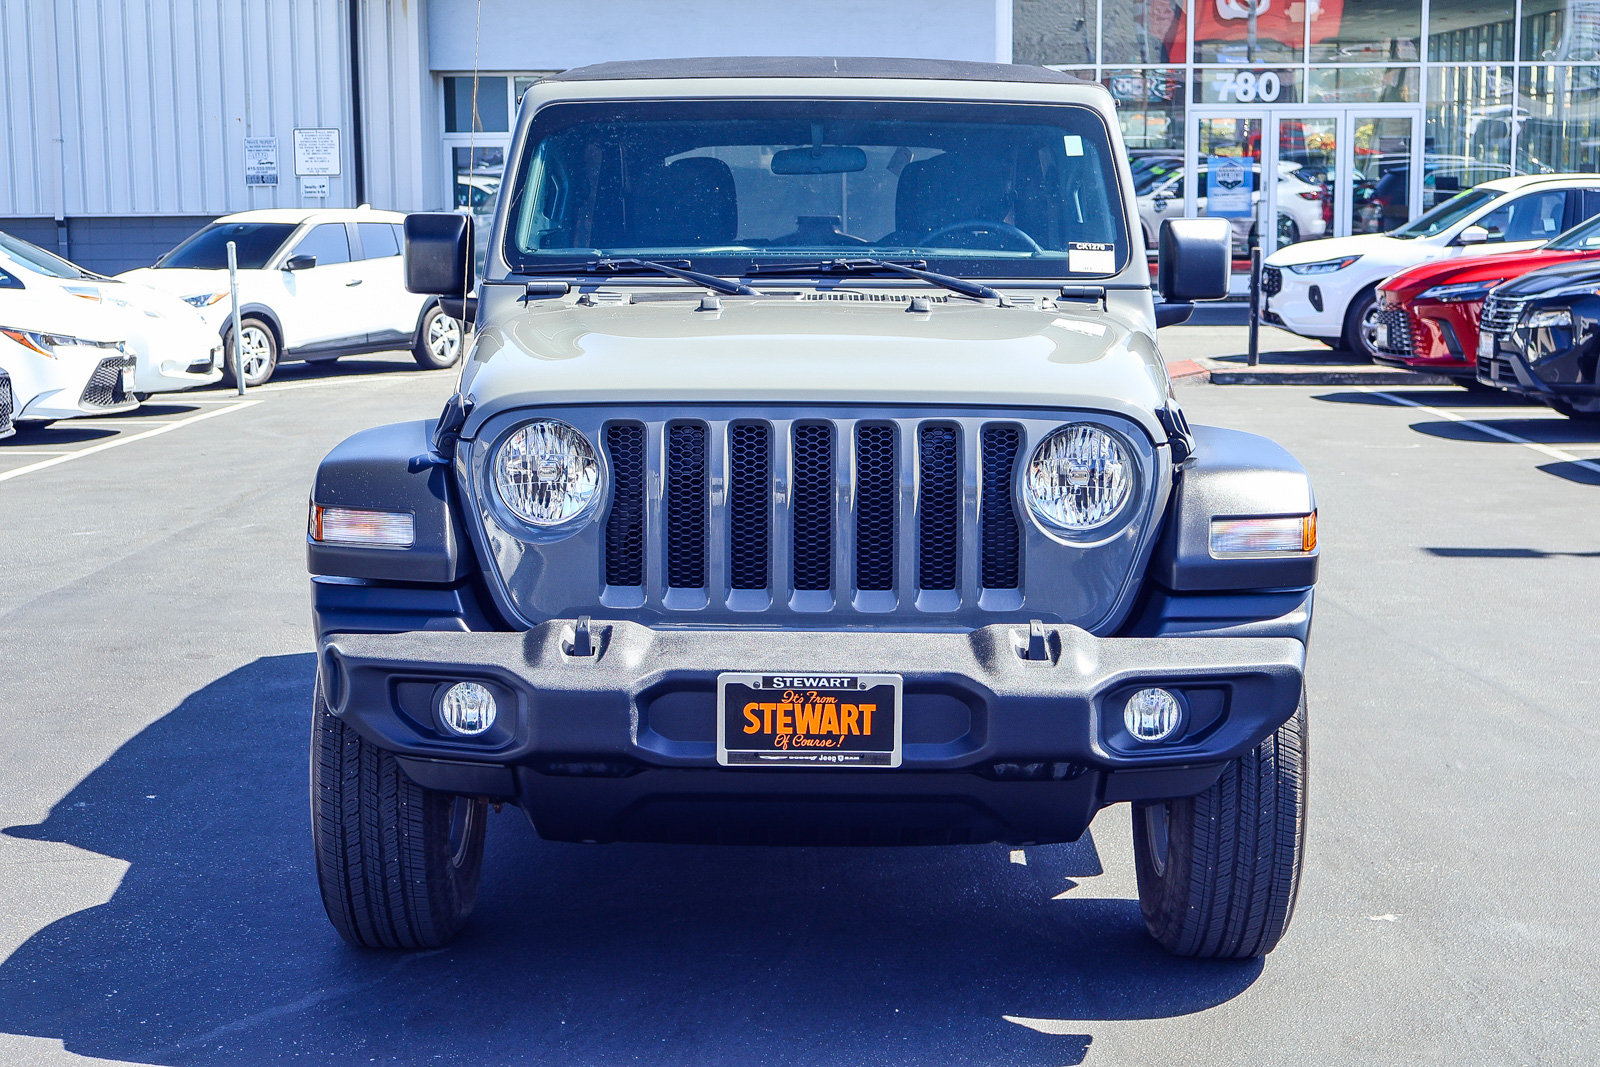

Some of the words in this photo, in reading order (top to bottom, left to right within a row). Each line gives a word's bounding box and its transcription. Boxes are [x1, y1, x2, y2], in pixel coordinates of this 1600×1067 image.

[1216, 71, 1280, 102] 780
[772, 677, 850, 688] STEWART
[781, 690, 805, 704] It's
[806, 690, 838, 704] From
[743, 702, 877, 735] STEWART
[774, 734, 790, 750] Of
[818, 754, 836, 762] Jeep
